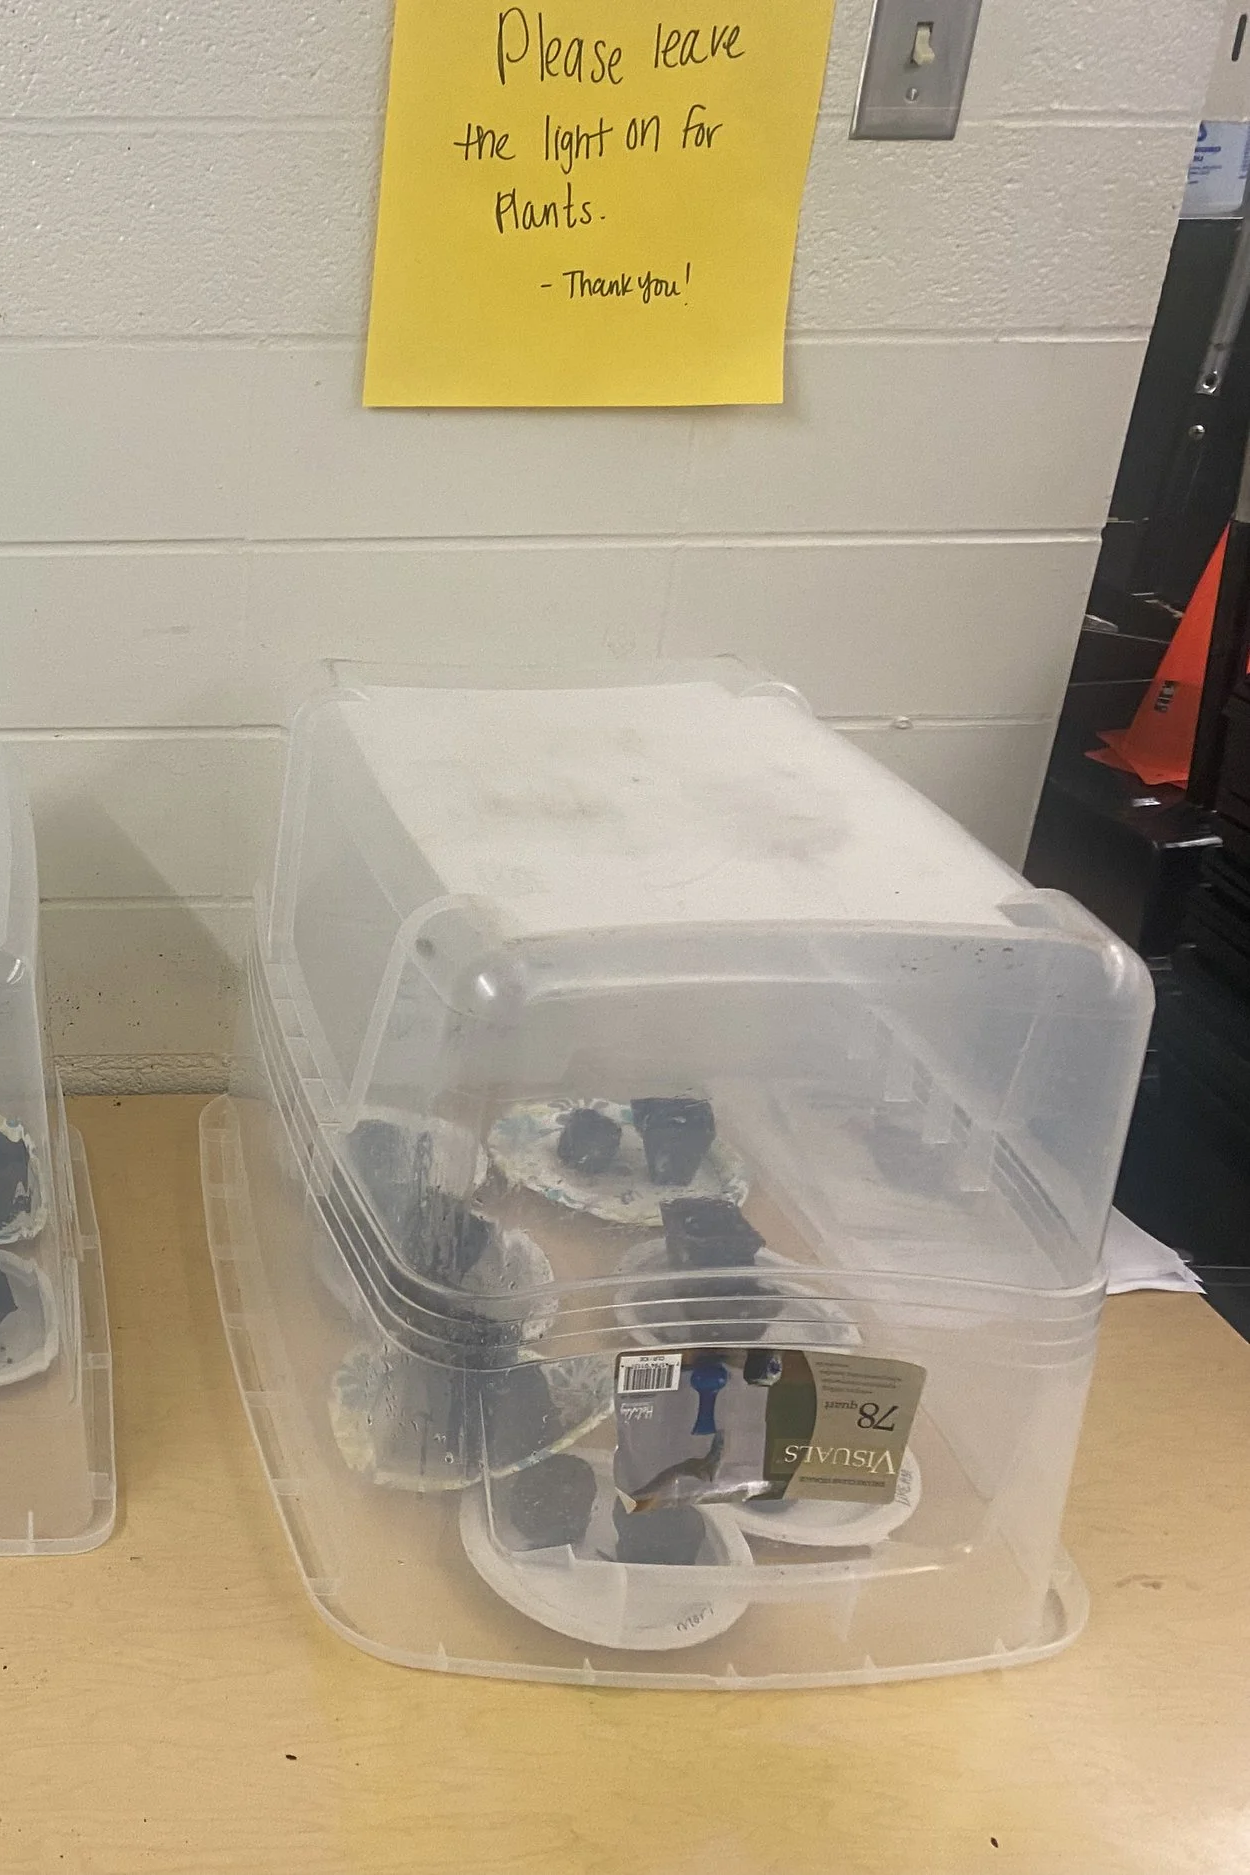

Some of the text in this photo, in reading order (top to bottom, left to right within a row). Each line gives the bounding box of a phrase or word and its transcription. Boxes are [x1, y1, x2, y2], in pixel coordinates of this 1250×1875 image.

[497, 6, 746, 85] Please leave
[453, 104, 724, 175] the light on for
[824, 1401, 899, 1431] 78 quart
[784, 1445, 896, 1475] VISUALS
